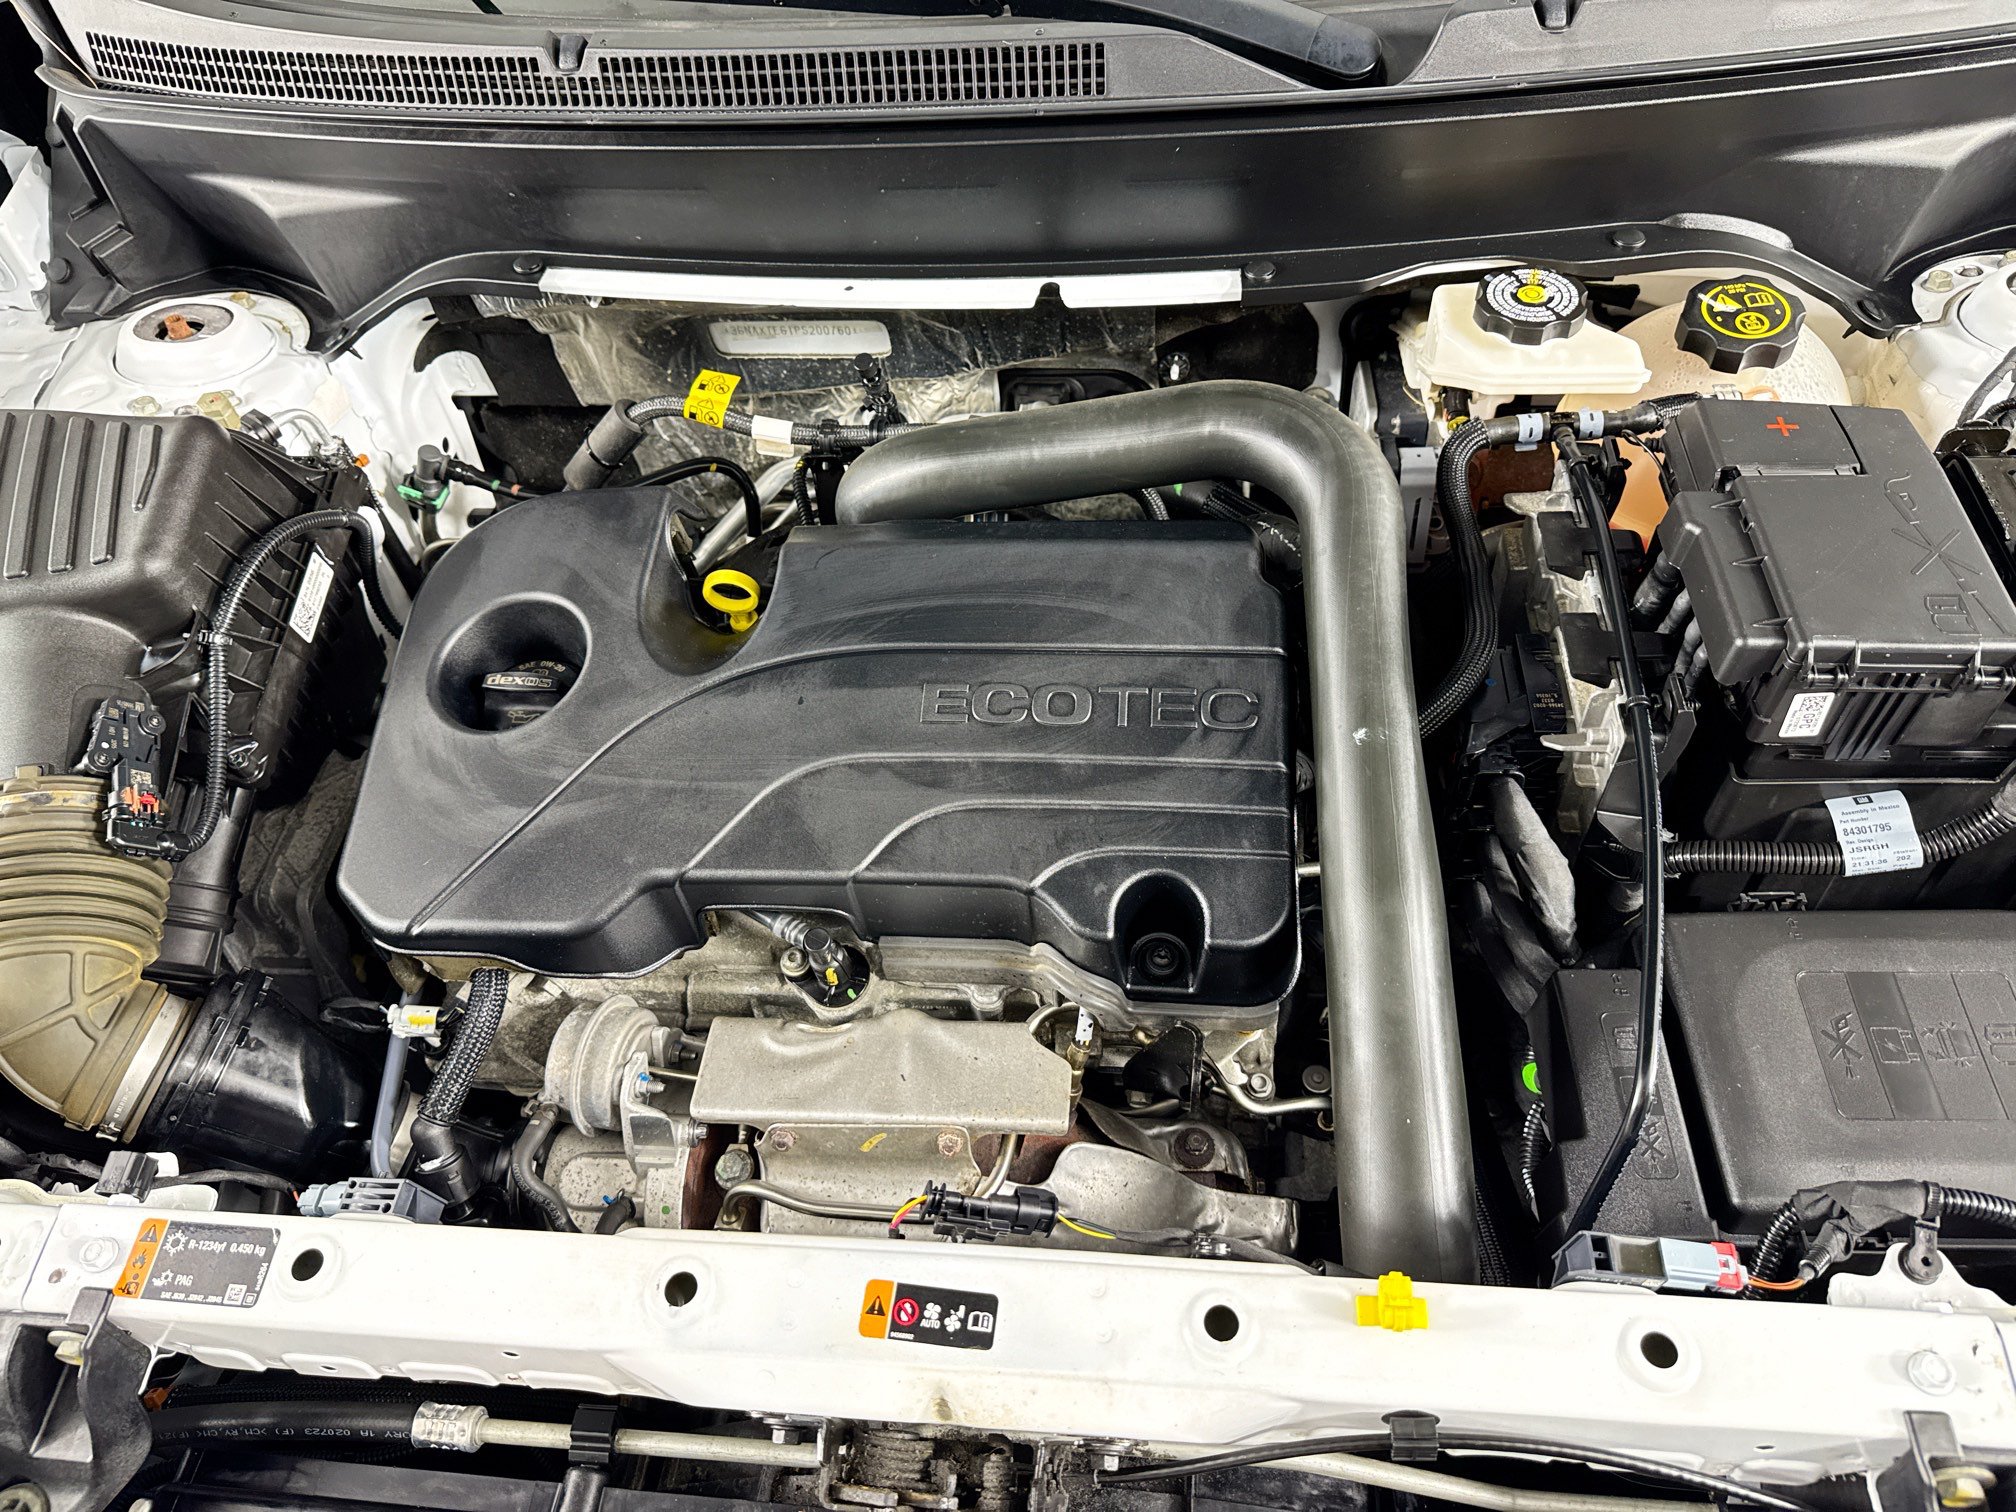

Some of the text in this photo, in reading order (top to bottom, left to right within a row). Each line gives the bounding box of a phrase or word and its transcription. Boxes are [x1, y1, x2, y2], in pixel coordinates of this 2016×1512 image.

[518, 660, 566, 672] SAE 0W-20
[487, 674, 552, 688] dexos
[920, 683, 1259, 730] ECOTEC
[1799, 713, 1815, 729] GPC
[1841, 808, 1869, 816] Assembly
[1843, 822, 1892, 837] 84301795
[1849, 843, 1889, 853] JSRGH
[1852, 859, 1888, 867] 21:31:36
[188, 1238, 266, 1257] R-1234yf 0.450 kg
[174, 1274, 194, 1286] PAG
[920, 1318, 941, 1329] AUTO
[304, 1427, 351, 1436] 020723
